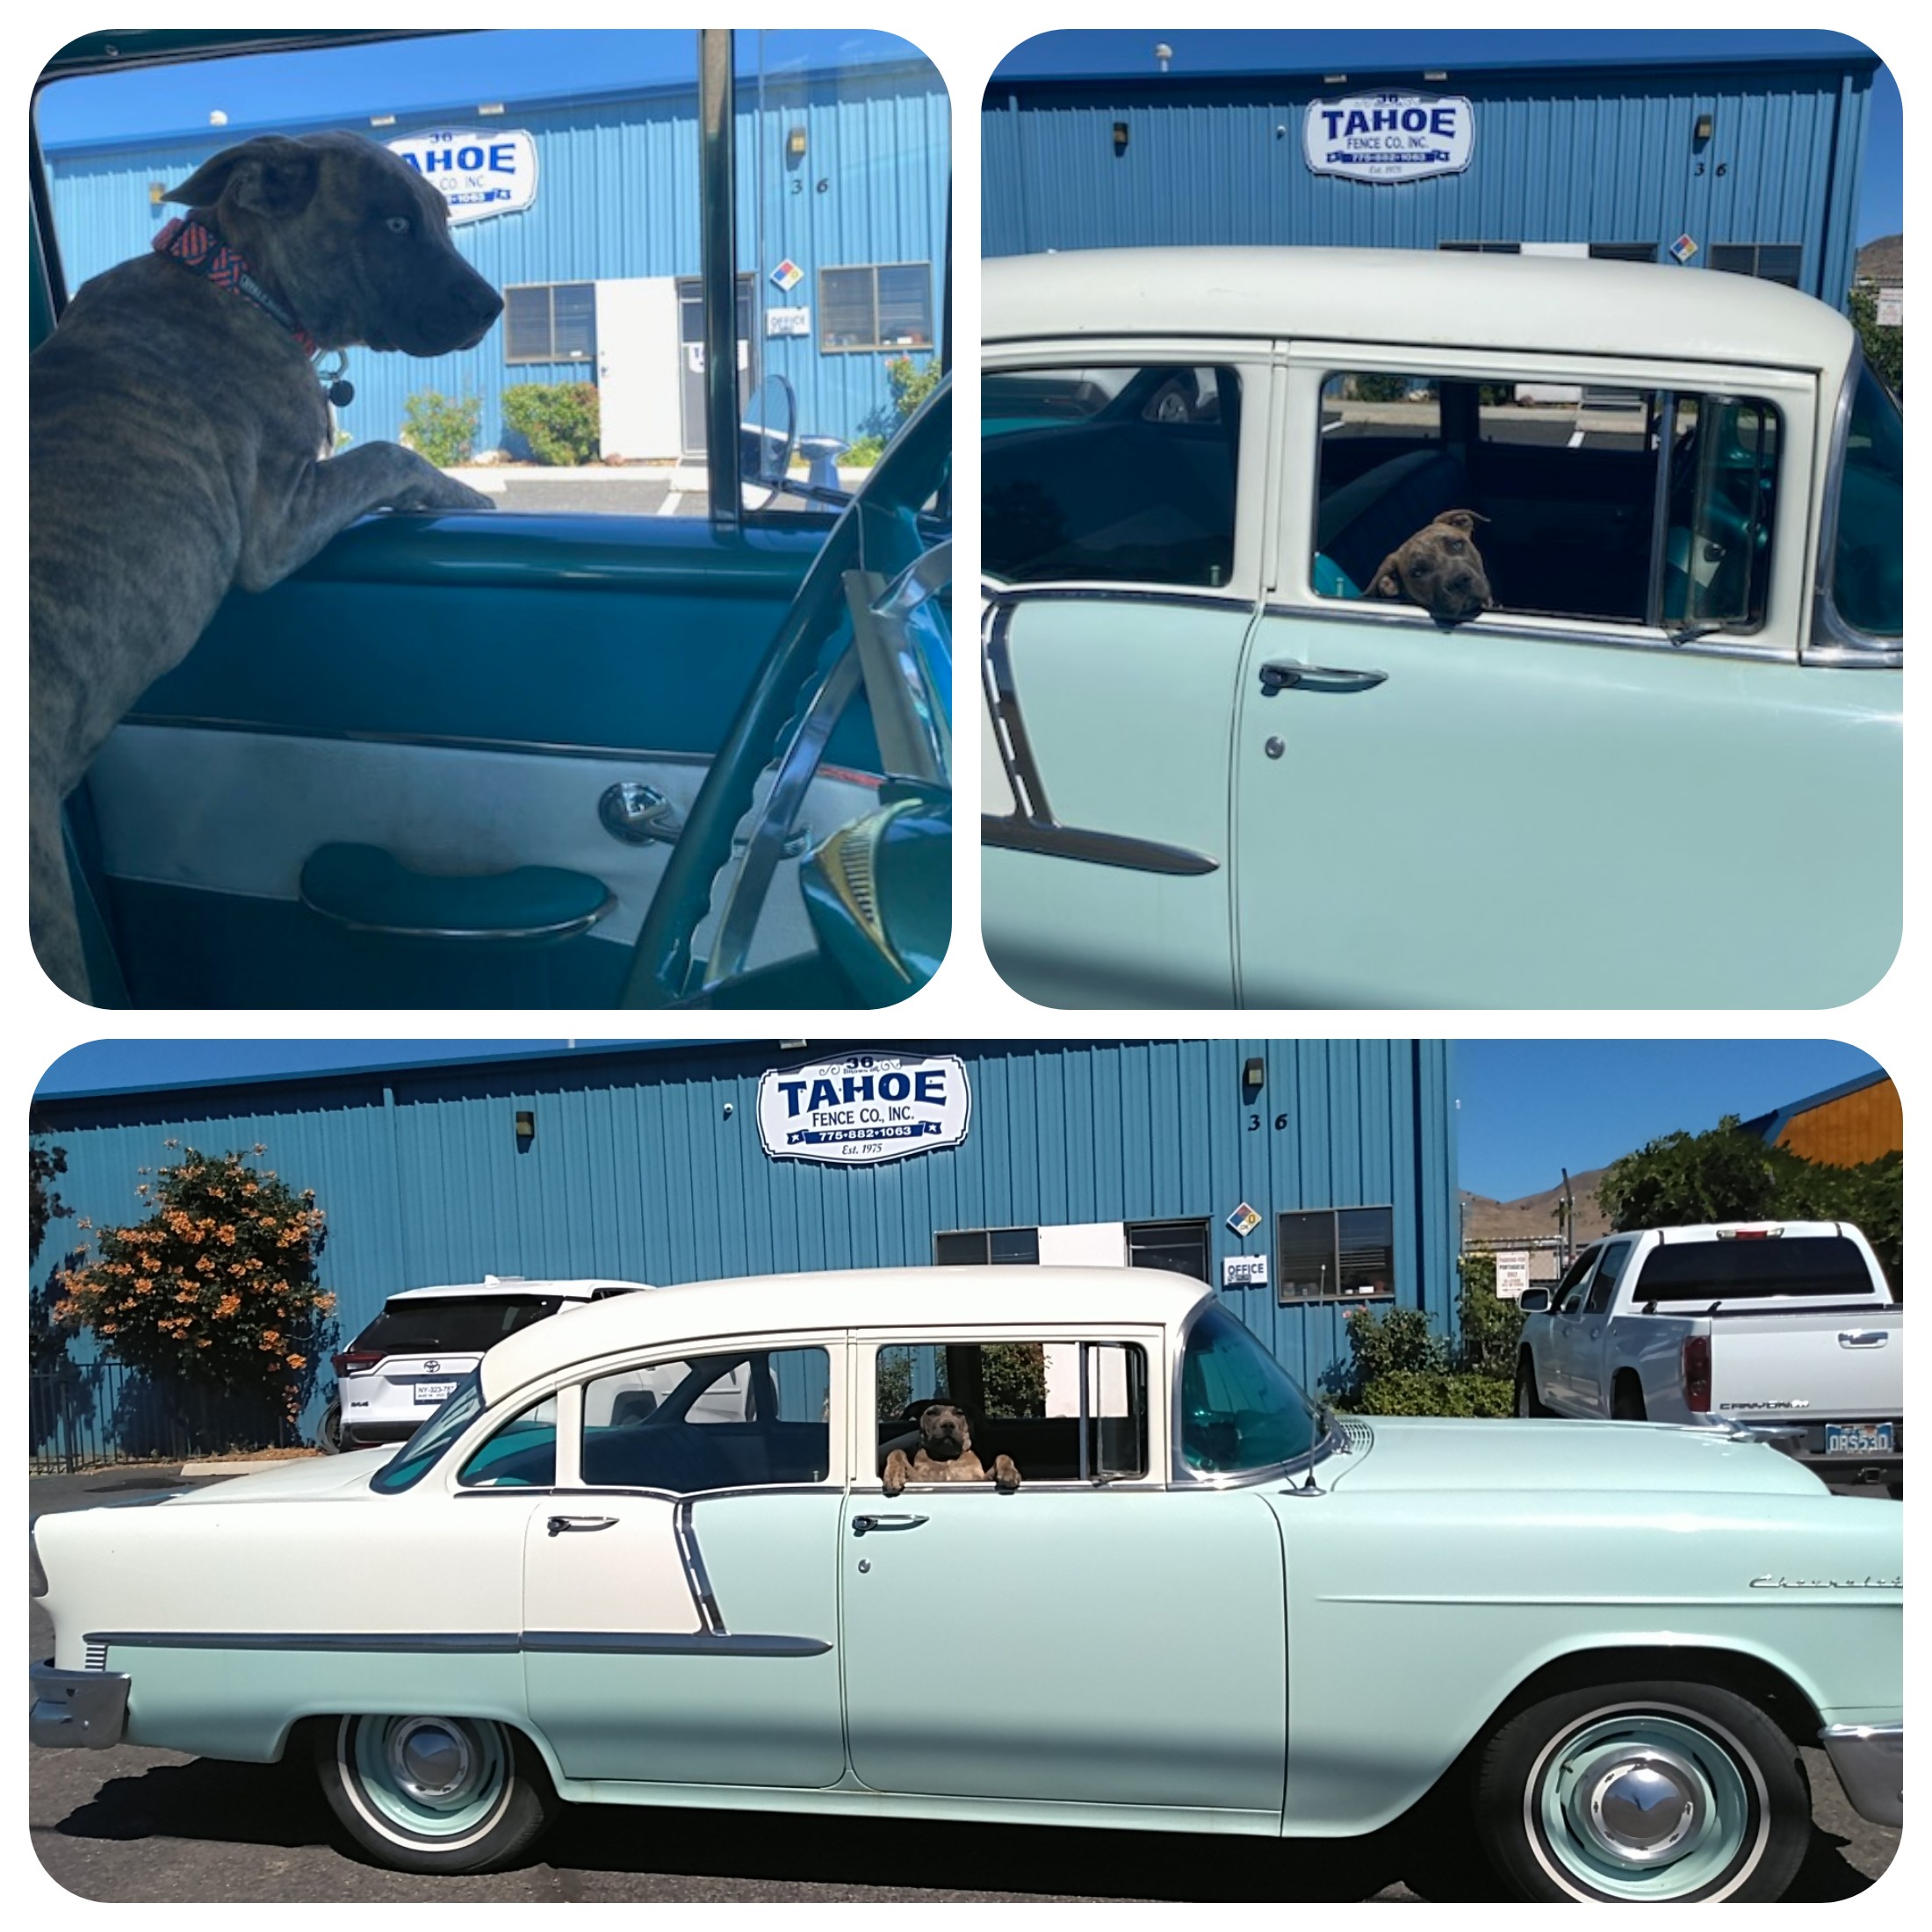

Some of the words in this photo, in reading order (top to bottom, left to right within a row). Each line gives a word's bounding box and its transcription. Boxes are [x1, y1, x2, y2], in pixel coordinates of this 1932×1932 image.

[1321, 108, 1456, 141] TAHOE
[1347, 136, 1381, 149] FENCE
[400, 143, 516, 175] AHOE
[846, 1056, 874, 1070] 36
[778, 1070, 948, 1119] TAHOE
[812, 1111, 854, 1128] FENCE
[860, 1107, 884, 1125] CO.,
[889, 1106, 915, 1121] INC.
[842, 1144, 859, 1155] Est.
[861, 1143, 883, 1154] 1975
[1228, 1263, 1265, 1276] OFFICE
[1719, 1401, 1791, 1410] CANYON
[1748, 1574, 1904, 1589] Chevrolet
